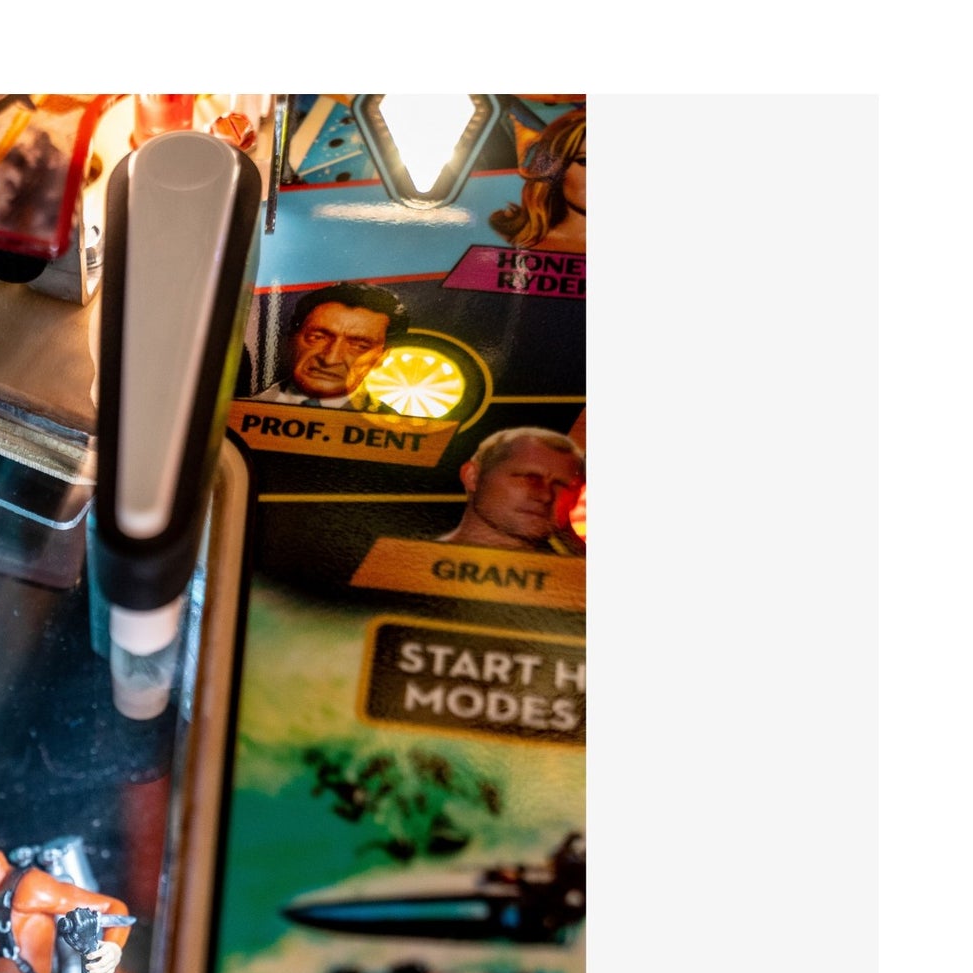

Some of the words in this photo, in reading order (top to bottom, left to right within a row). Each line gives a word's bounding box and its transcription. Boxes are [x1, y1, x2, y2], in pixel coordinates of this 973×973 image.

[497, 252, 586, 276] HONE
[240, 413, 330, 442] PROF.
[342, 424, 428, 452] DENT
[431, 557, 550, 591] GRANT
[397, 641, 544, 686] START
[403, 680, 578, 731] MODES
